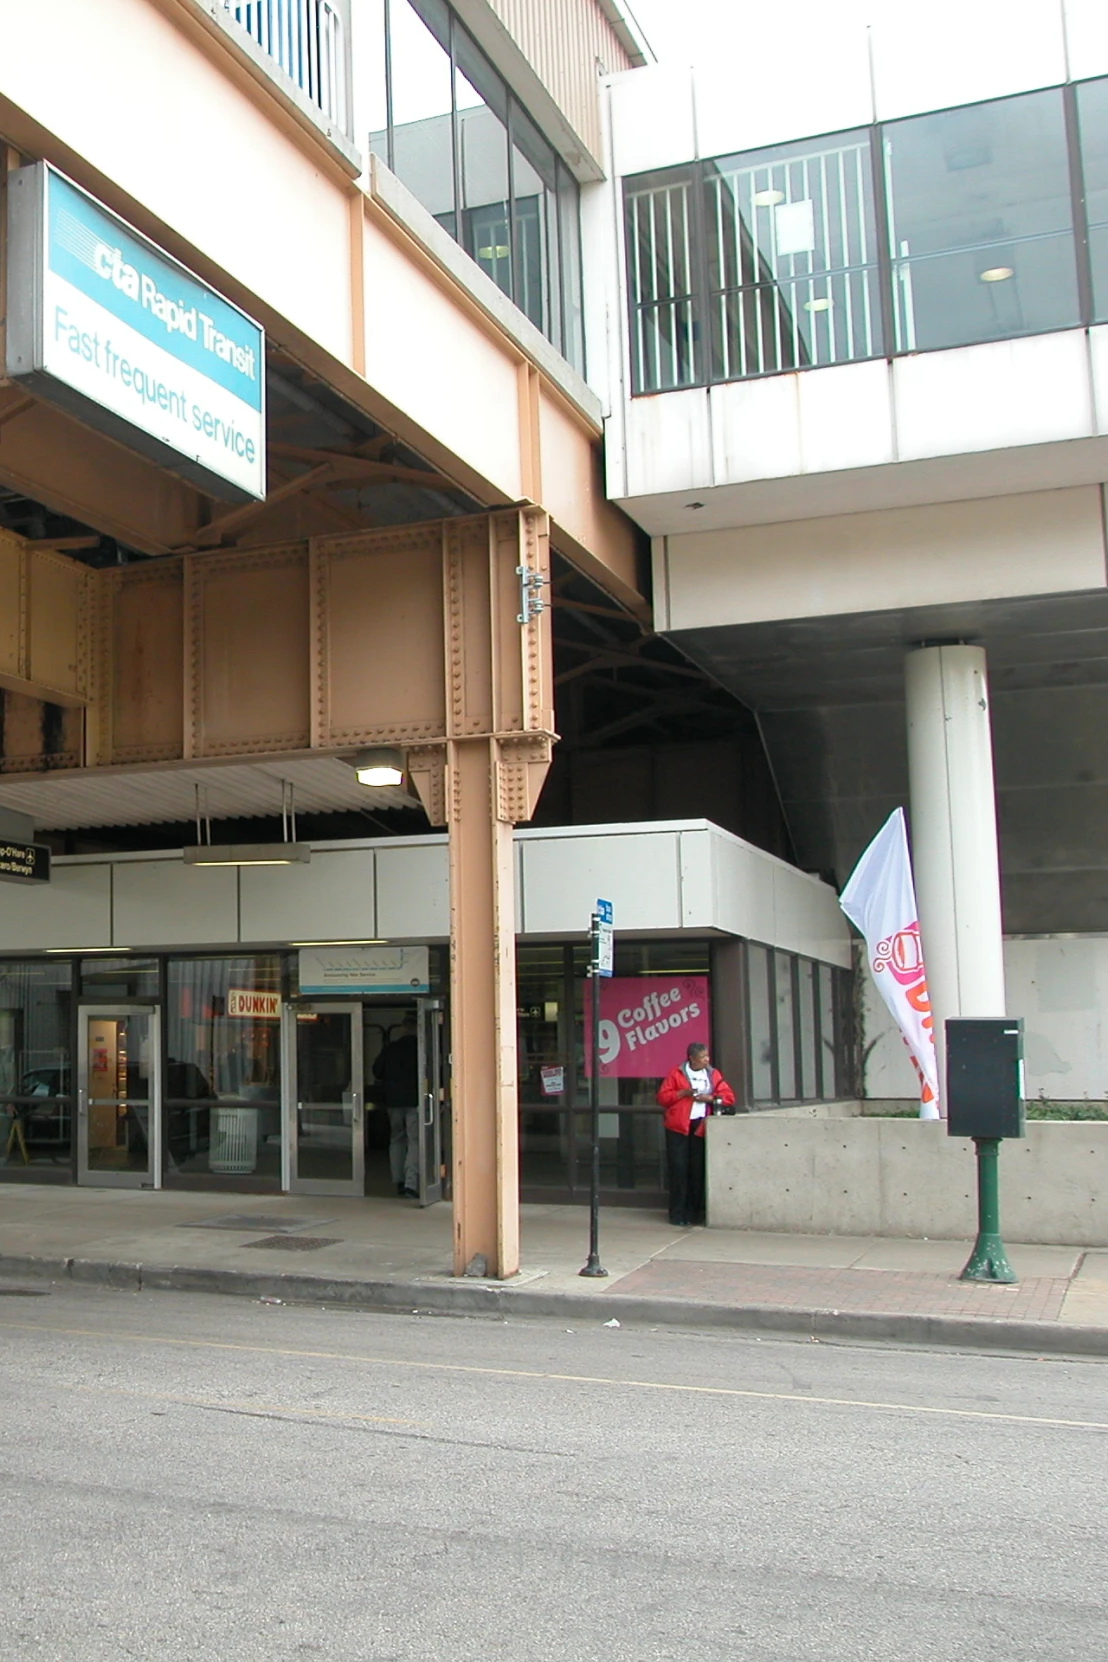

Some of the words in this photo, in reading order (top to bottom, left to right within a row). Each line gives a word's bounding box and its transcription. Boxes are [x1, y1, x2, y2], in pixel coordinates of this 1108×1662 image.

[94, 244, 140, 301] cta
[141, 275, 197, 341] Rapid
[199, 312, 256, 381] Transit
[54, 305, 100, 370] Fast
[105, 338, 187, 421] frequent
[193, 402, 256, 464] service
[598, 1018, 621, 1064] 9
[625, 1003, 700, 1051] Flavors
[618, 988, 680, 1028] Coffee
